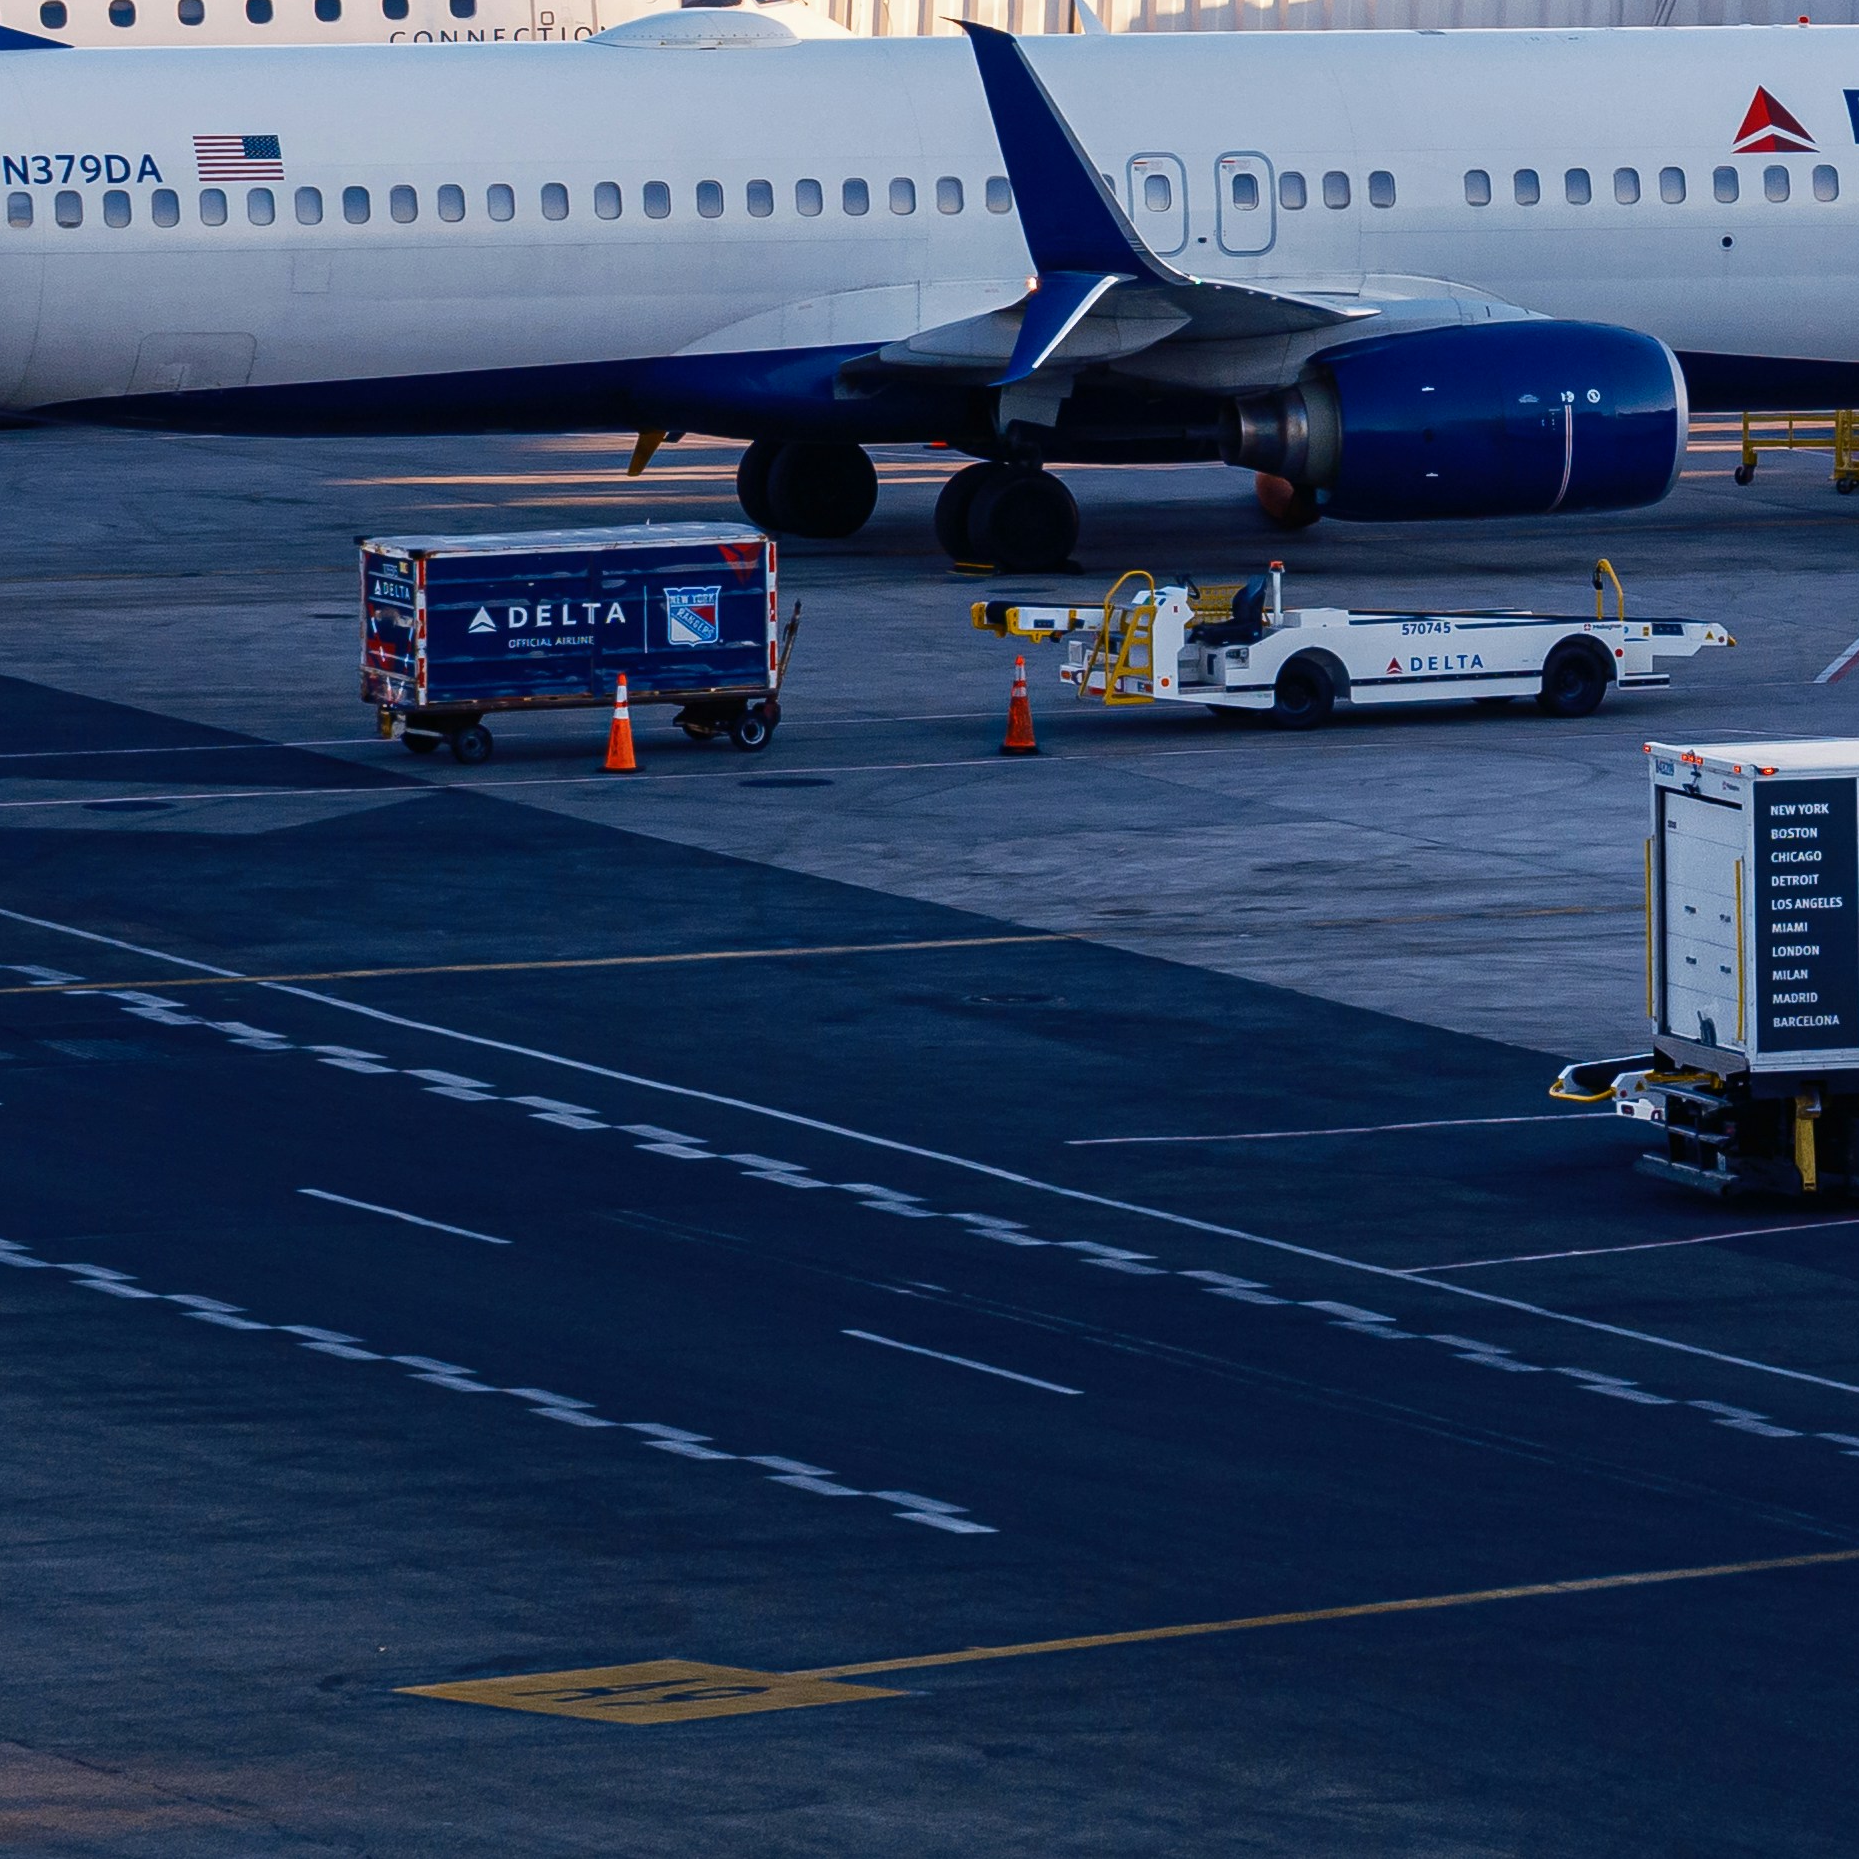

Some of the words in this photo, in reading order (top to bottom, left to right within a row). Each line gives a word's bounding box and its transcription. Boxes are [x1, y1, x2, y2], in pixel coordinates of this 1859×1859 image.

[389, 27, 618, 44] CONNECTIO
[3, 153, 164, 186] N379DA
[383, 581, 411, 600] DELTA
[670, 594, 690, 605] NEW
[691, 593, 715, 604] YORK
[508, 603, 626, 628] DELTA
[676, 608, 715, 640] RANGERS
[1401, 621, 1452, 636] 570745
[508, 636, 552, 649] OFFICIAL
[554, 634, 596, 647] AIRLINE
[1410, 654, 1484, 673] DELTA
[1770, 805, 1795, 816] NEW
[1798, 803, 1829, 815] YORK
[1771, 828, 1818, 840] BOSTON
[1771, 851, 1822, 863] CHICAGO
[1771, 874, 1819, 887] DETROIT
[1771, 898, 1793, 910] LOS
[1794, 897, 1843, 909] ANGELES
[1772, 922, 1808, 934] MIAMI
[1772, 945, 1820, 957] LONDON
[1772, 969, 1808, 981] MILAN
[1773, 992, 1818, 1004] MADRID
[1773, 1015, 1840, 1028] BARCELONA
